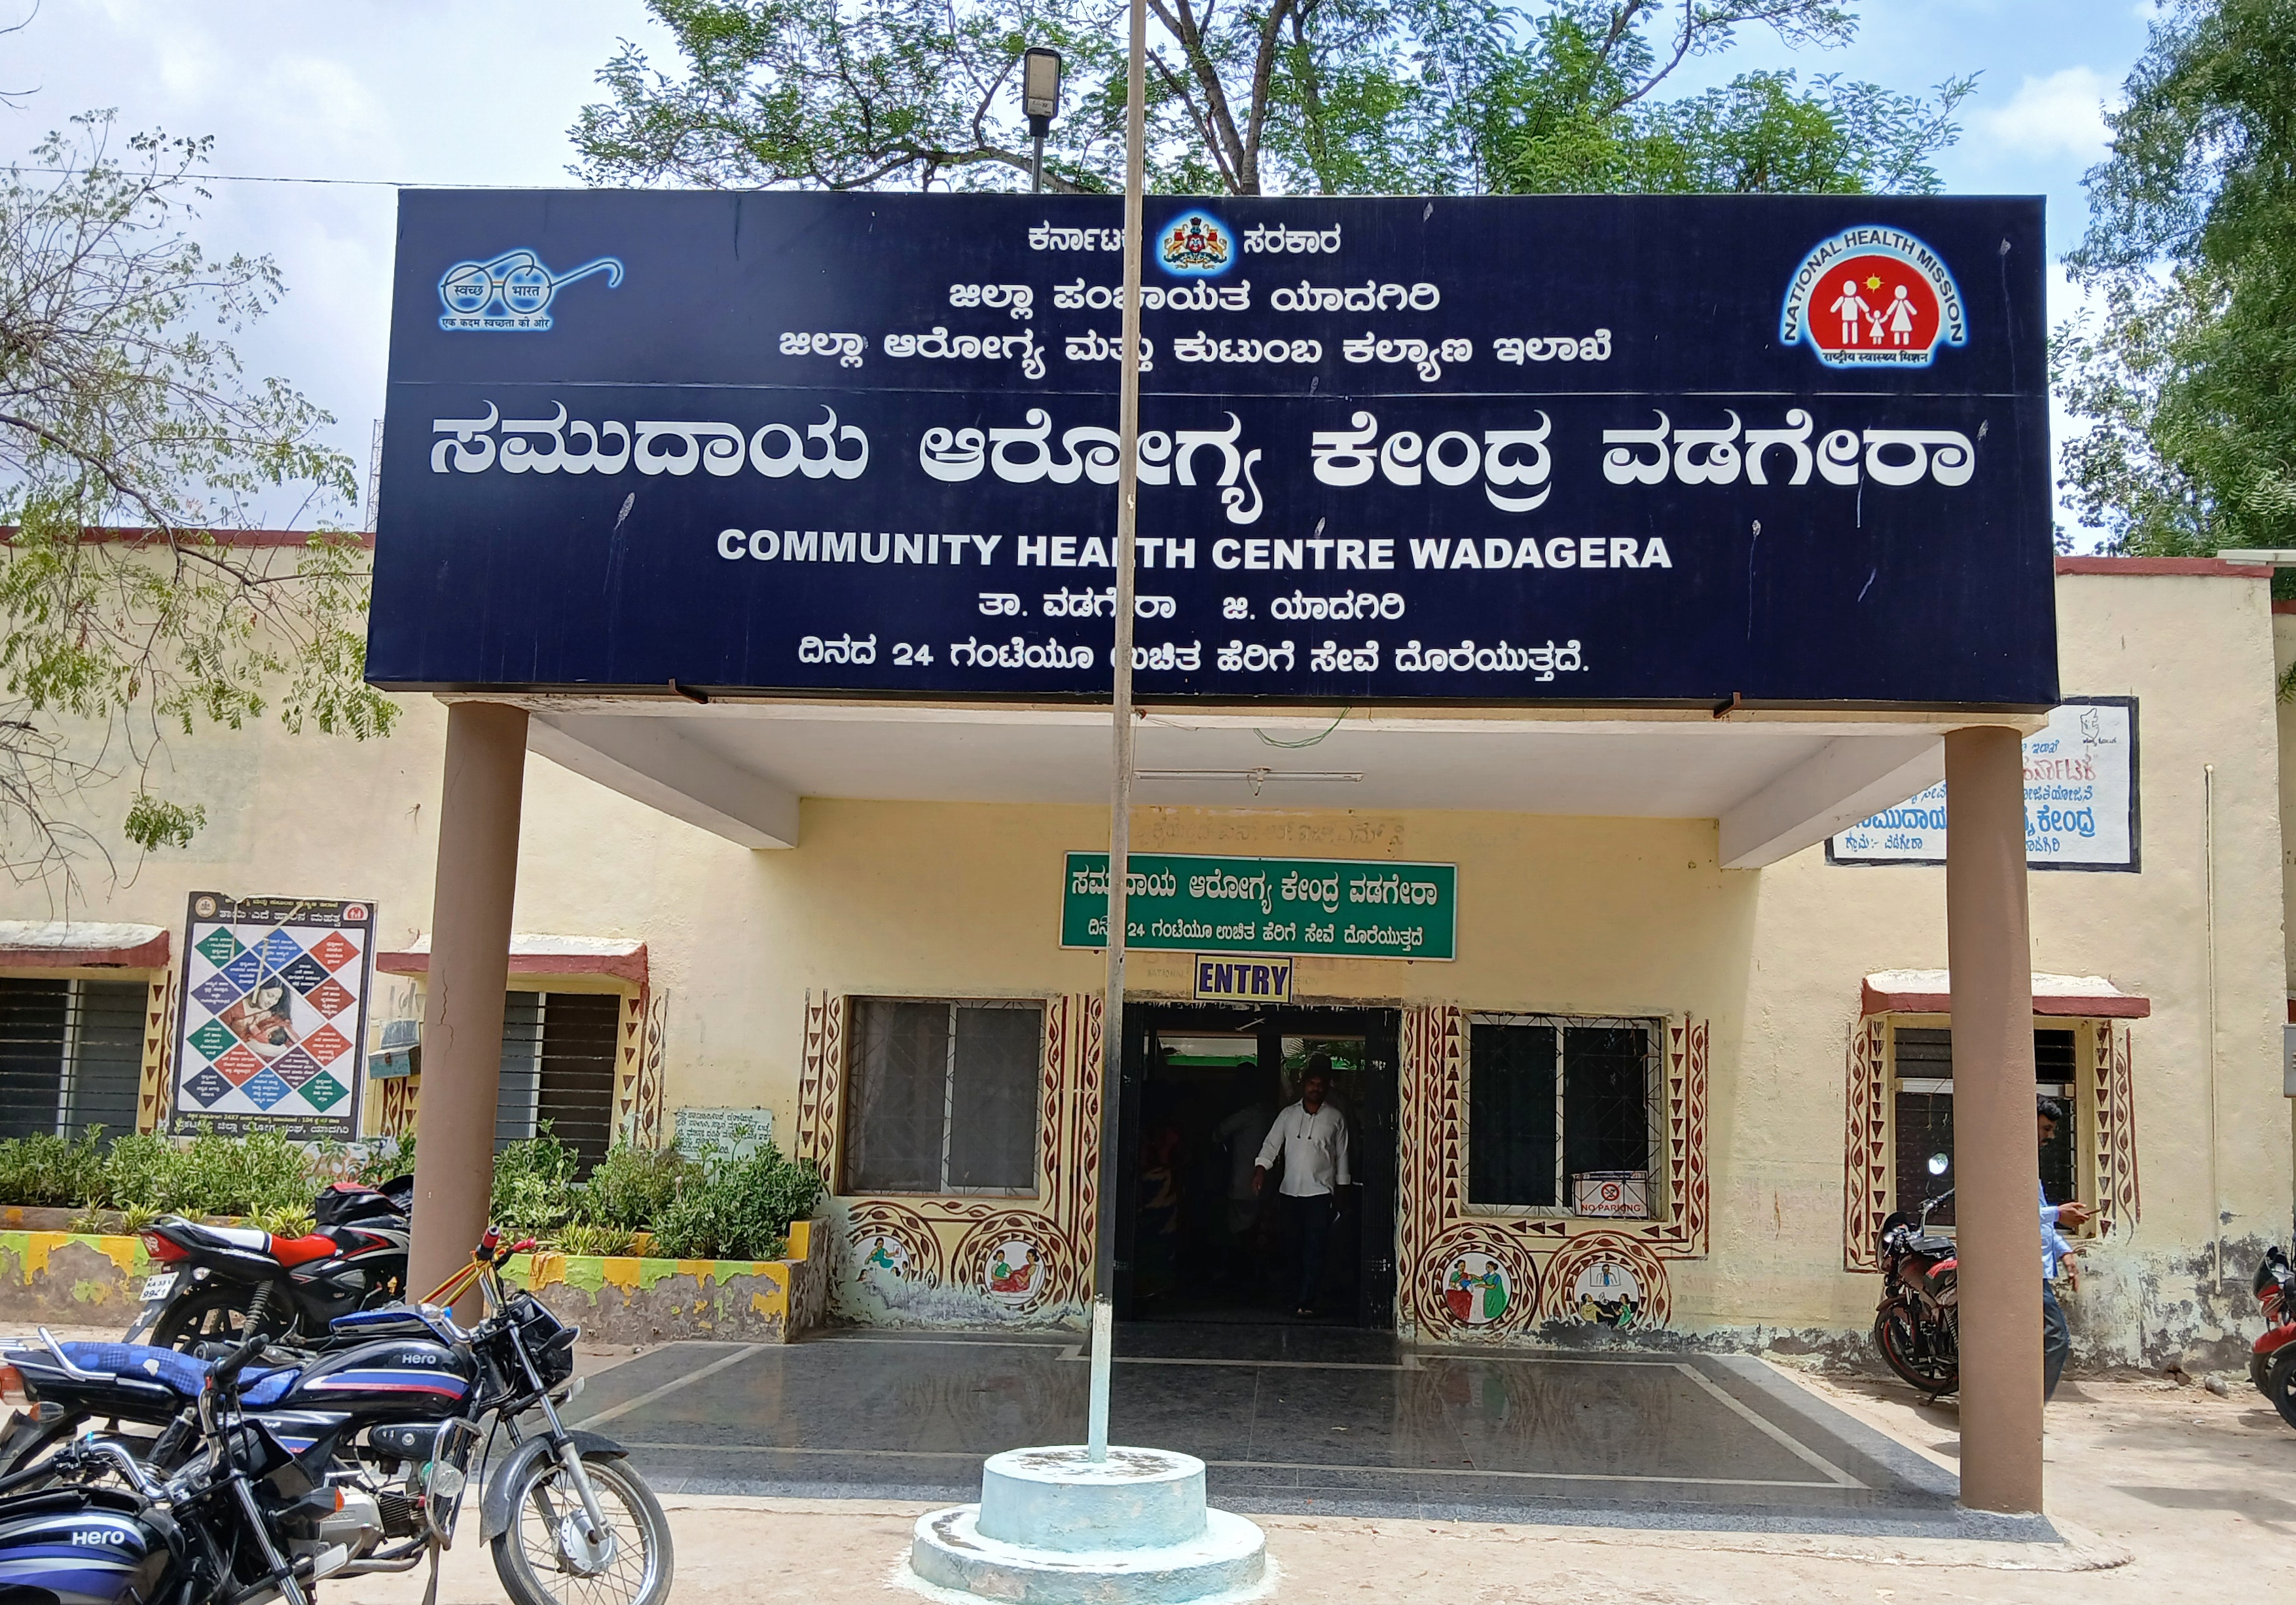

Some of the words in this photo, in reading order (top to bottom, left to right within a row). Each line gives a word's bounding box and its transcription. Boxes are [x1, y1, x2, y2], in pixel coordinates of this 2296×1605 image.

[1029, 221, 1125, 251] ಕರ್ನಾಟ
[1244, 223, 1340, 253] ಸರಕಾರ
[454, 285, 484, 296] स्वच्छ
[512, 286, 541, 297] भारत
[950, 284, 1033, 320] ಜಿಲ್ಲಾ
[1271, 280, 1440, 311] ಯಾದಗಿರಿ
[1784, 240, 1842, 341] NATIONAL
[1844, 229, 1916, 255] HEALTH
[1916, 248, 1963, 342] MISSION
[442, 318, 457, 328] एक
[460, 318, 481, 328] कदम
[483, 318, 515, 327] स्वच्छता
[518, 316, 530, 327] की
[780, 332, 863, 368] ಜಿಲ್ಲಾ
[884, 326, 1046, 380] ಆರೋಗ್ಯ
[1175, 330, 1322, 363] ಕುಟುಂಬ
[1343, 331, 1472, 382] ಕಲ್ಯಾಣ
[1493, 329, 1611, 365] ಇಲಾಖೆ
[1822, 350, 1855, 364] राष्ट्रीय
[1899, 350, 1929, 363] मिशन
[431, 400, 869, 479] ಸಮುದಾಯ
[919, 408, 1262, 525] ಆರೋಗ್ಯ
[1311, 411, 1552, 512] ಕೇಂದ್ರ
[1603, 409, 1975, 487] ವಡಗೇರಾ
[718, 529, 1002, 565] COMMUNITY
[1212, 538, 1394, 570] CENTRE
[1410, 537, 1672, 569] WADAGERA
[979, 592, 1028, 616] ತಾ.
[1271, 589, 1405, 620] ಯಾದಗಿರಿ
[799, 634, 877, 665] ದಿನದ
[893, 643, 934, 666] 24
[951, 636, 1094, 669] ಗಂಟೆಯೂ
[1217, 640, 1295, 672] ಹೆರಿಗೆ
[1311, 640, 1379, 673] ಸೇವೆ
[1396, 639, 1589, 682] ದೊರೆಯುತ್ತದೆ.
[2037, 805, 2096, 838] ಕೇಂದ್ರ
[1189, 868, 1273, 915] ಆರೋಗ್ಯ
[1281, 870, 1339, 913] ಕೇಂದ್ರ
[1349, 872, 1438, 906] ವಡಗೇರಾ
[1088, 917, 1109, 936] ದಿನ
[1127, 922, 1146, 937] 24
[1152, 918, 1212, 938] ಗಂಟೆಯೂ
[1216, 921, 1256, 941] ಉಚಿತ
[1262, 921, 1297, 942] ಹೆರಿಗೆ
[1305, 923, 1335, 944] ಸೇವೆ
[1344, 923, 1424, 951] ದೊರೆಯುತ್ತದೆ
[1198, 963, 1289, 996] ENTRY
[401, 1354, 437, 1365] Hero
[72, 1530, 125, 1545] Hero
